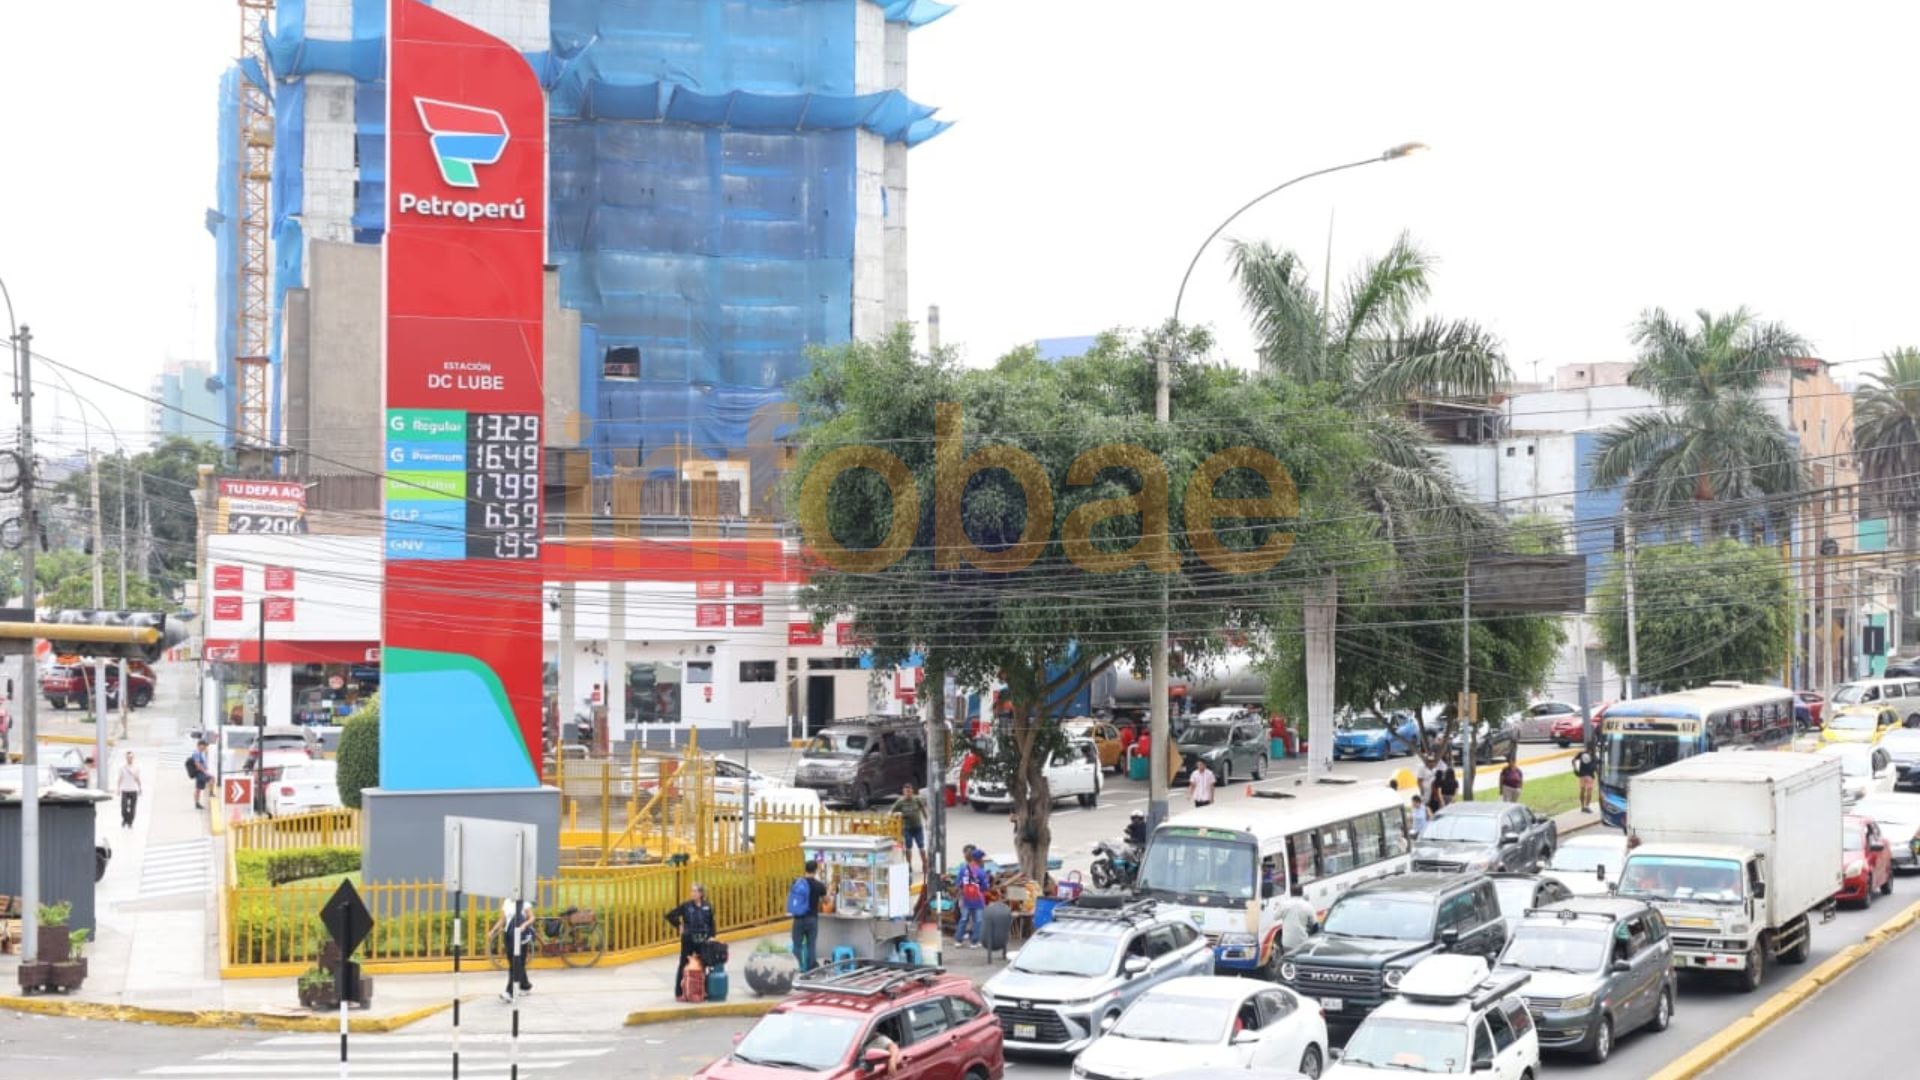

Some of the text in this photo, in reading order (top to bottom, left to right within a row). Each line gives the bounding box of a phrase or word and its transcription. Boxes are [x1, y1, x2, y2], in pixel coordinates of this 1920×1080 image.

[399, 193, 525, 222] Petroperú
[443, 361, 491, 372] ESTACIÓN
[428, 374, 505, 390] DC LUBE
[390, 415, 539, 441] G Regular 13.29
[390, 447, 405, 462] G
[477, 445, 539, 470] 16.49
[226, 484, 243, 495] TU
[246, 486, 279, 498] DEPA
[390, 509, 420, 521] GLP
[390, 539, 424, 551] GNV
[1310, 972, 1358, 983] HAVAL
